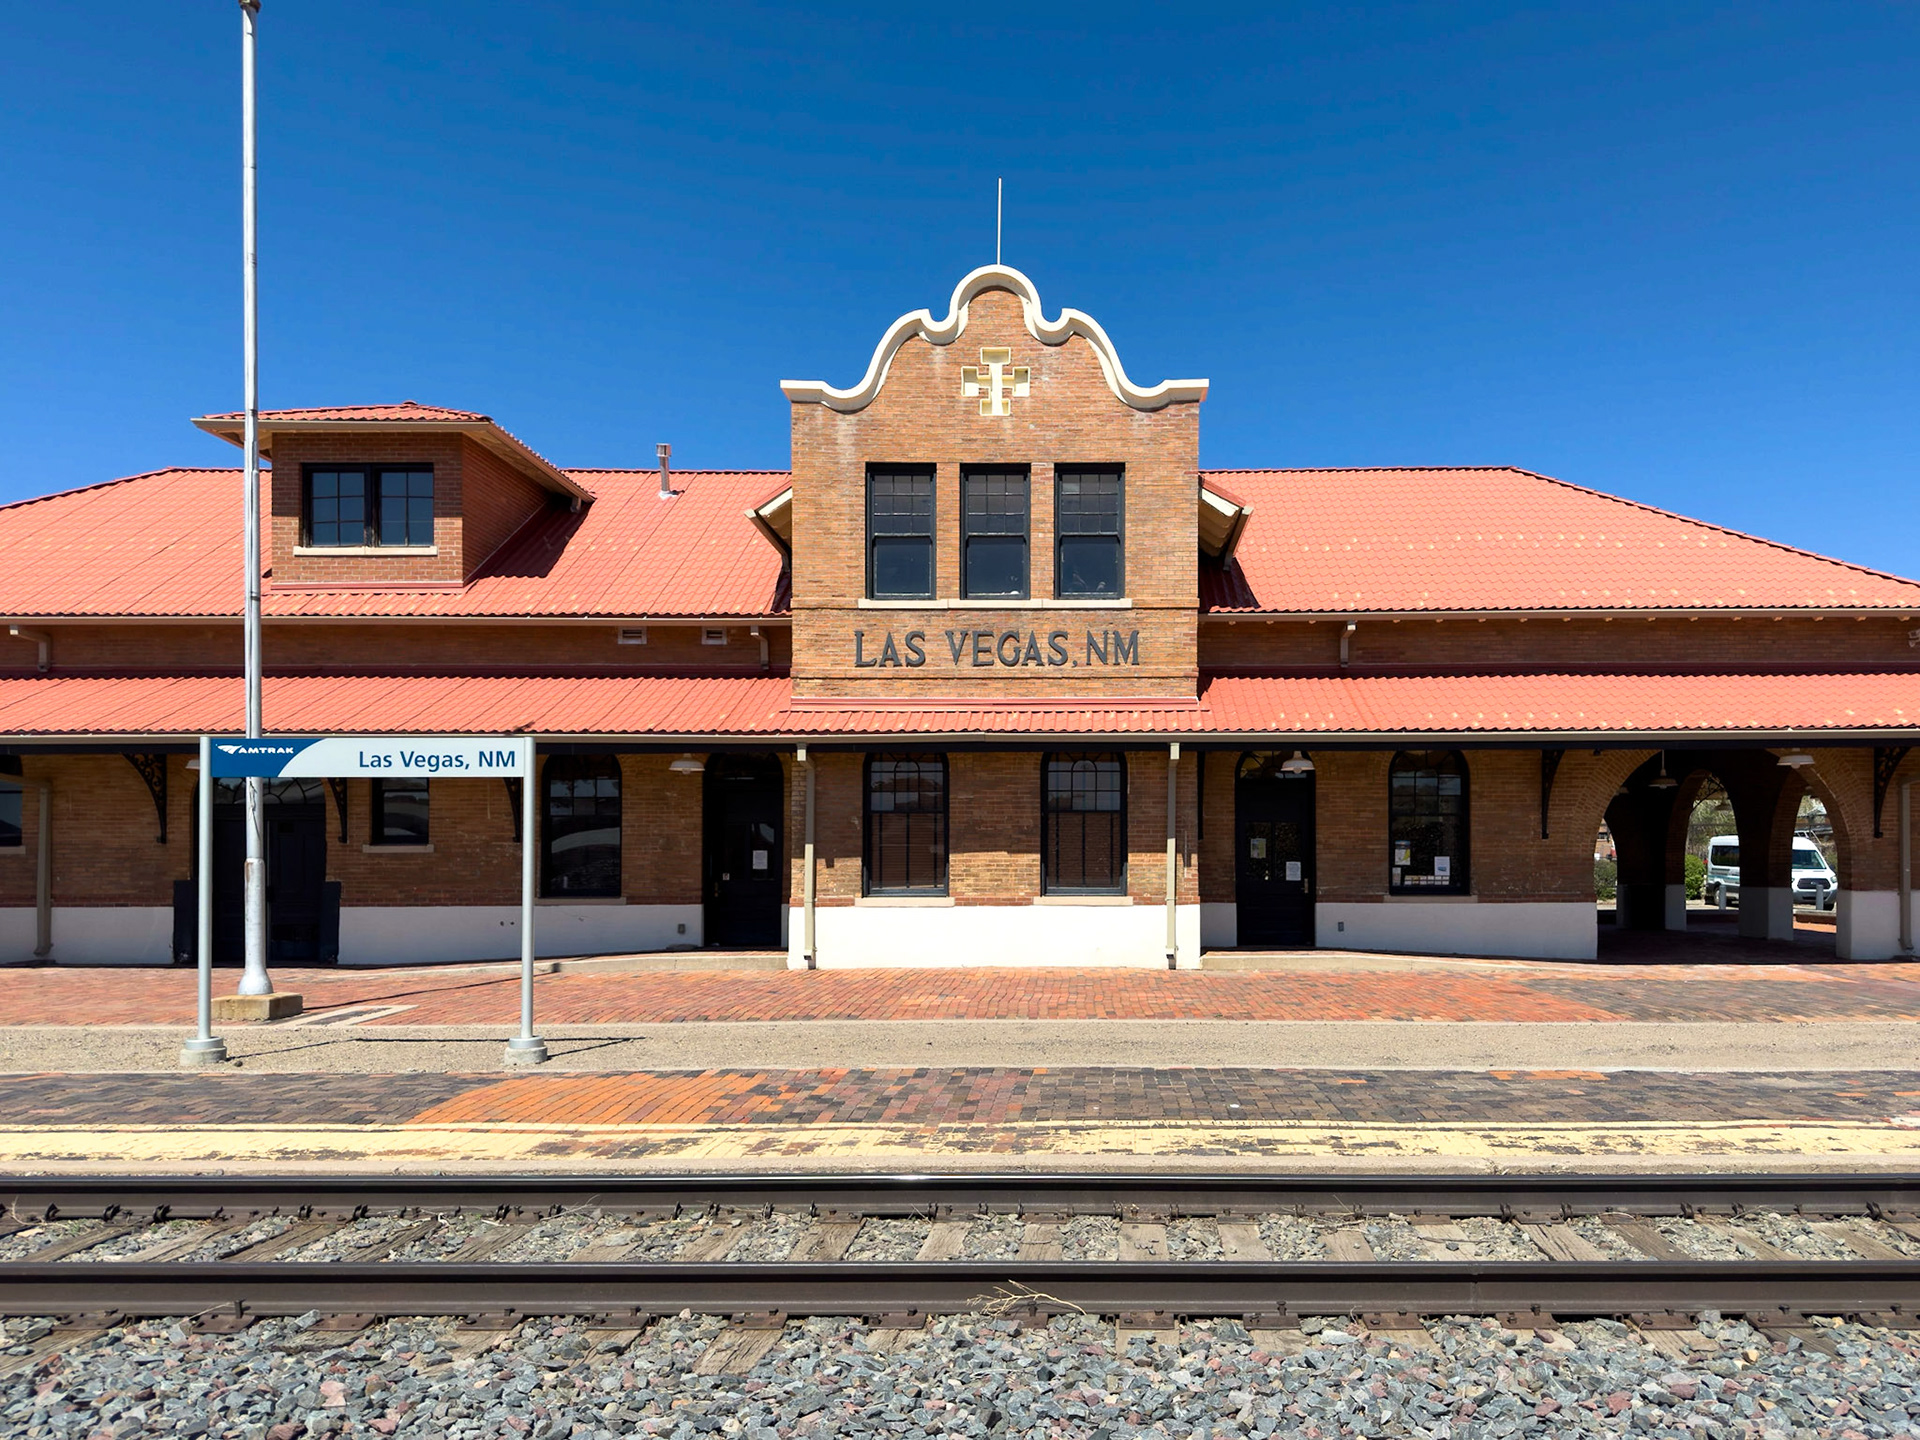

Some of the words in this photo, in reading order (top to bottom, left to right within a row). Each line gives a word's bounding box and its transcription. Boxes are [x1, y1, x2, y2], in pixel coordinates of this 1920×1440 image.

[854, 631, 926, 668] LAS
[945, 630, 1078, 668] VEGAS,
[1085, 630, 1140, 666] NM
[359, 751, 393, 768] Las
[399, 751, 470, 773] Vegas,
[478, 751, 516, 768] NM
